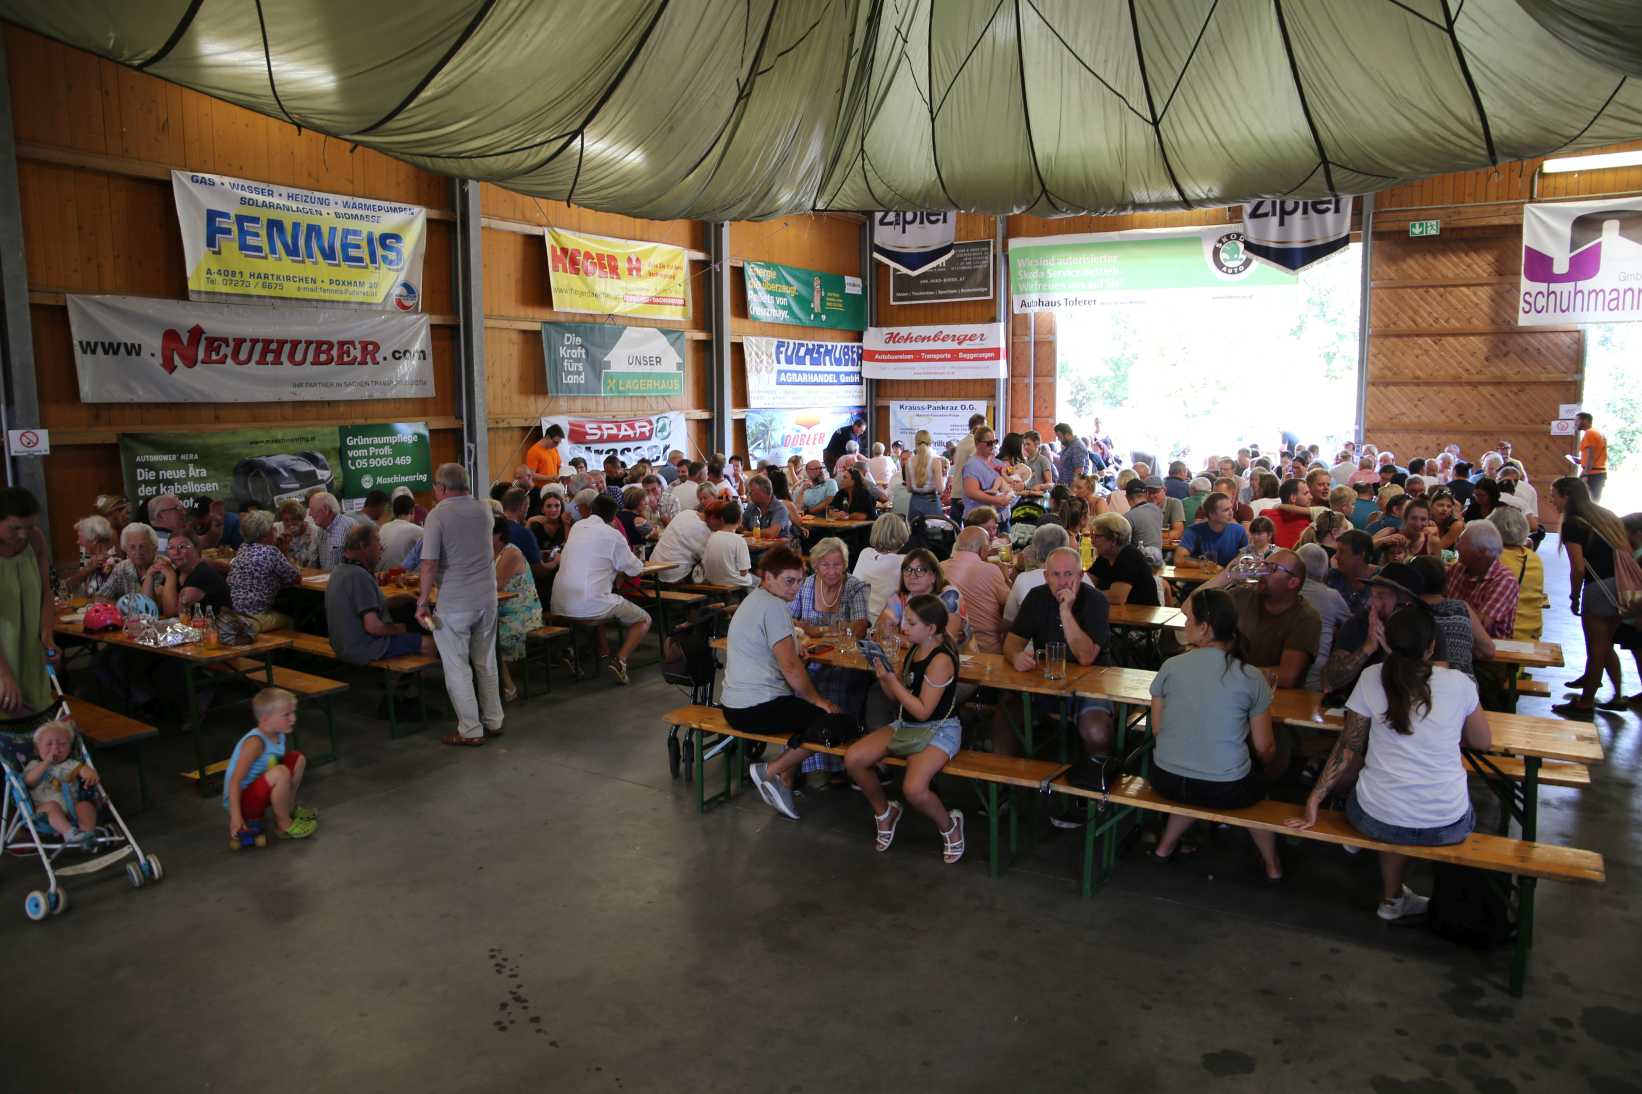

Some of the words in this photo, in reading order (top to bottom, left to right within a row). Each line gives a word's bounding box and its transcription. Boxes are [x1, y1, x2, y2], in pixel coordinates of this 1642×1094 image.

[191, 175, 215, 187] GAS
[229, 182, 274, 198] WASSER
[287, 193, 331, 206] HEIZUNG
[240, 197, 322, 216] SOLARANLAGEN
[334, 212, 382, 224] BIOMASSE
[206, 208, 405, 270] FENNEIS
[1221, 265, 1245, 274] AUTO
[249, 271, 316, 285] HARTKIRCHEN
[329, 279, 365, 288] POXHAM
[776, 296, 788, 306] von
[564, 333, 582, 345] Die
[884, 330, 986, 346] Hohenberger
[560, 347, 586, 359] Kraft
[563, 359, 584, 371] fürs
[628, 355, 662, 366] UNSER
[562, 373, 585, 384] Land
[780, 372, 838, 383] AGRARHANDEL
[618, 379, 680, 391] LAGERHAUS
[585, 421, 650, 440] SPAR
[346, 433, 418, 446] Grünraumpflege
[347, 449, 367, 457] vom
[370, 446, 392, 456] Profi:
[356, 459, 368, 468] 05
[369, 457, 393, 467] 9060
[395, 456, 412, 465] 469
[136, 468, 156, 481] Die
[159, 468, 186, 480] neue
[188, 463, 207, 478] Ära
[376, 473, 427, 485] Maschinenring
[138, 482, 157, 497] der
[160, 482, 219, 496] kabellosen
